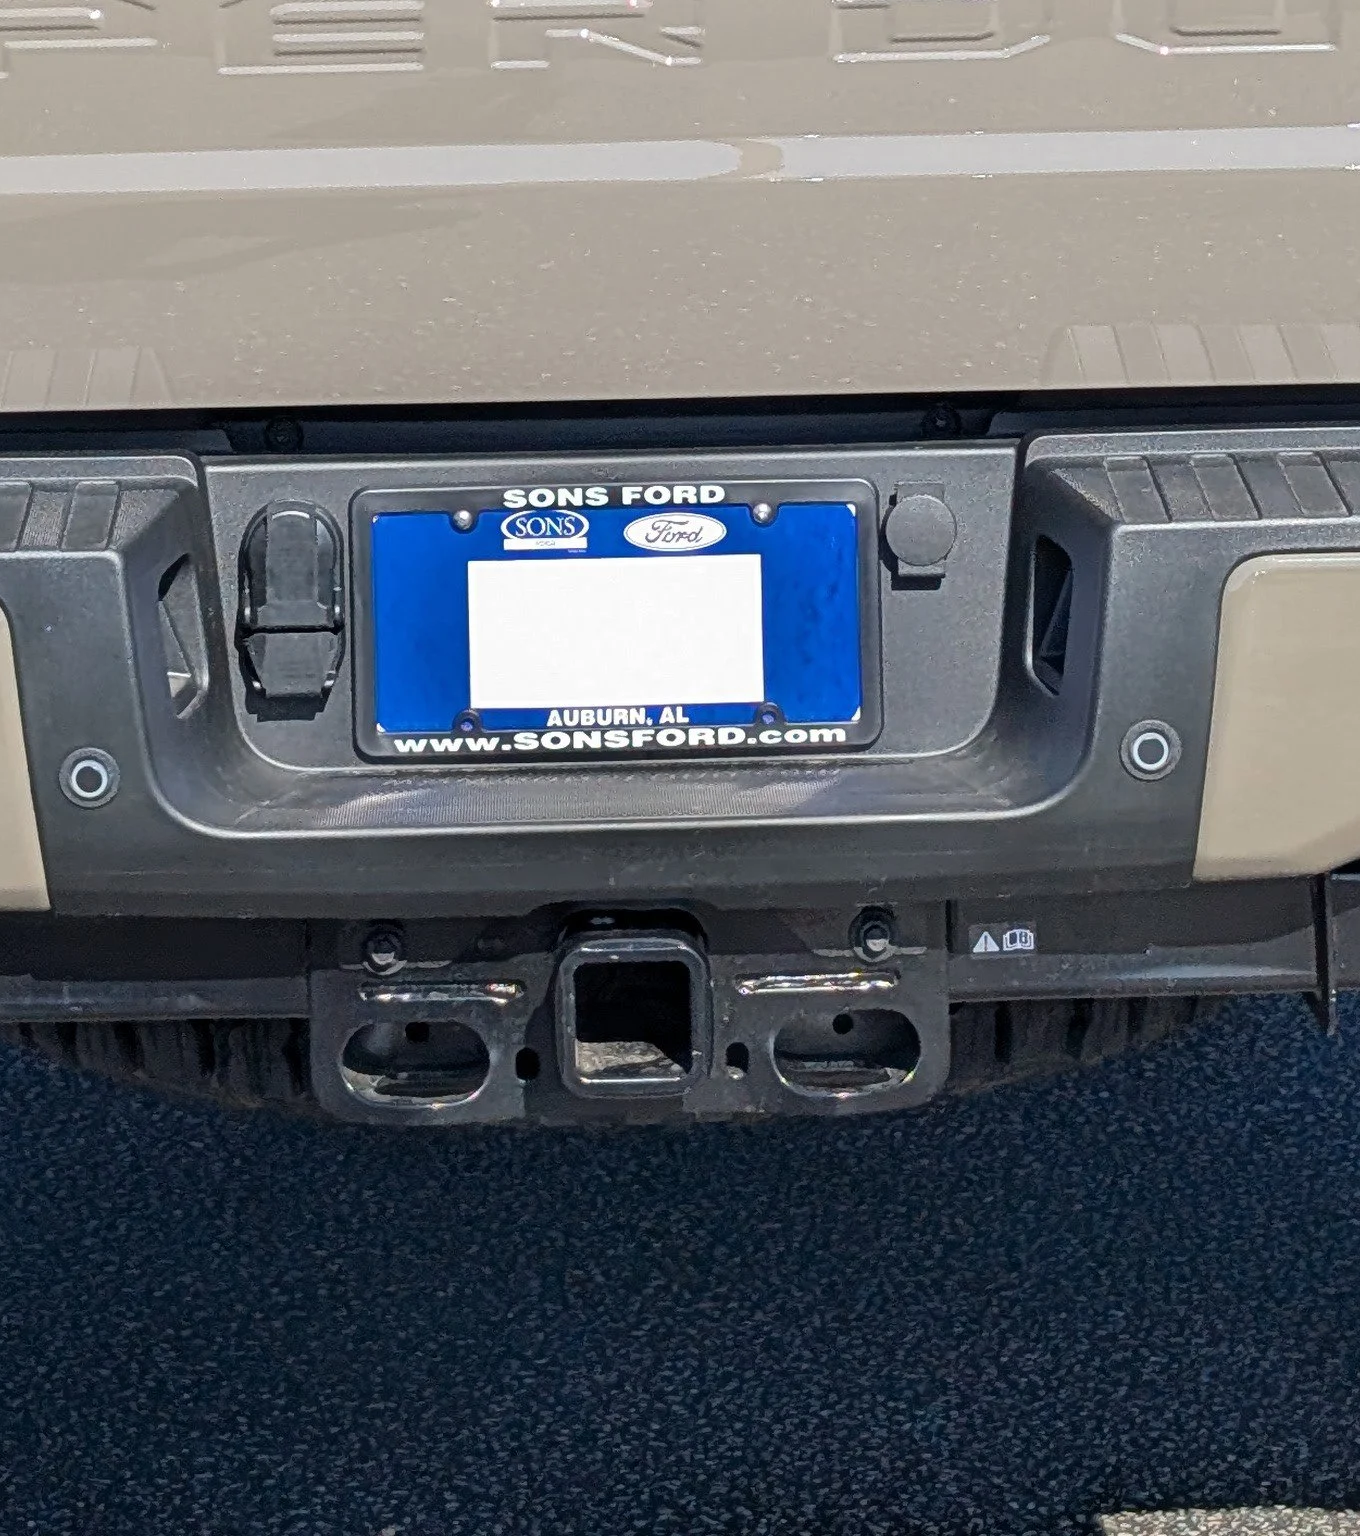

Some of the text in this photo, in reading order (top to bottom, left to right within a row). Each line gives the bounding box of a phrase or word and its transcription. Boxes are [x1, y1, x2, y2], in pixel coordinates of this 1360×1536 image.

[503, 485, 726, 508] SONS FORD
[515, 516, 576, 537] SONS
[644, 519, 704, 544] Ford
[659, 706, 689, 724] AL
[394, 728, 846, 753] www.SONSFORD.com
